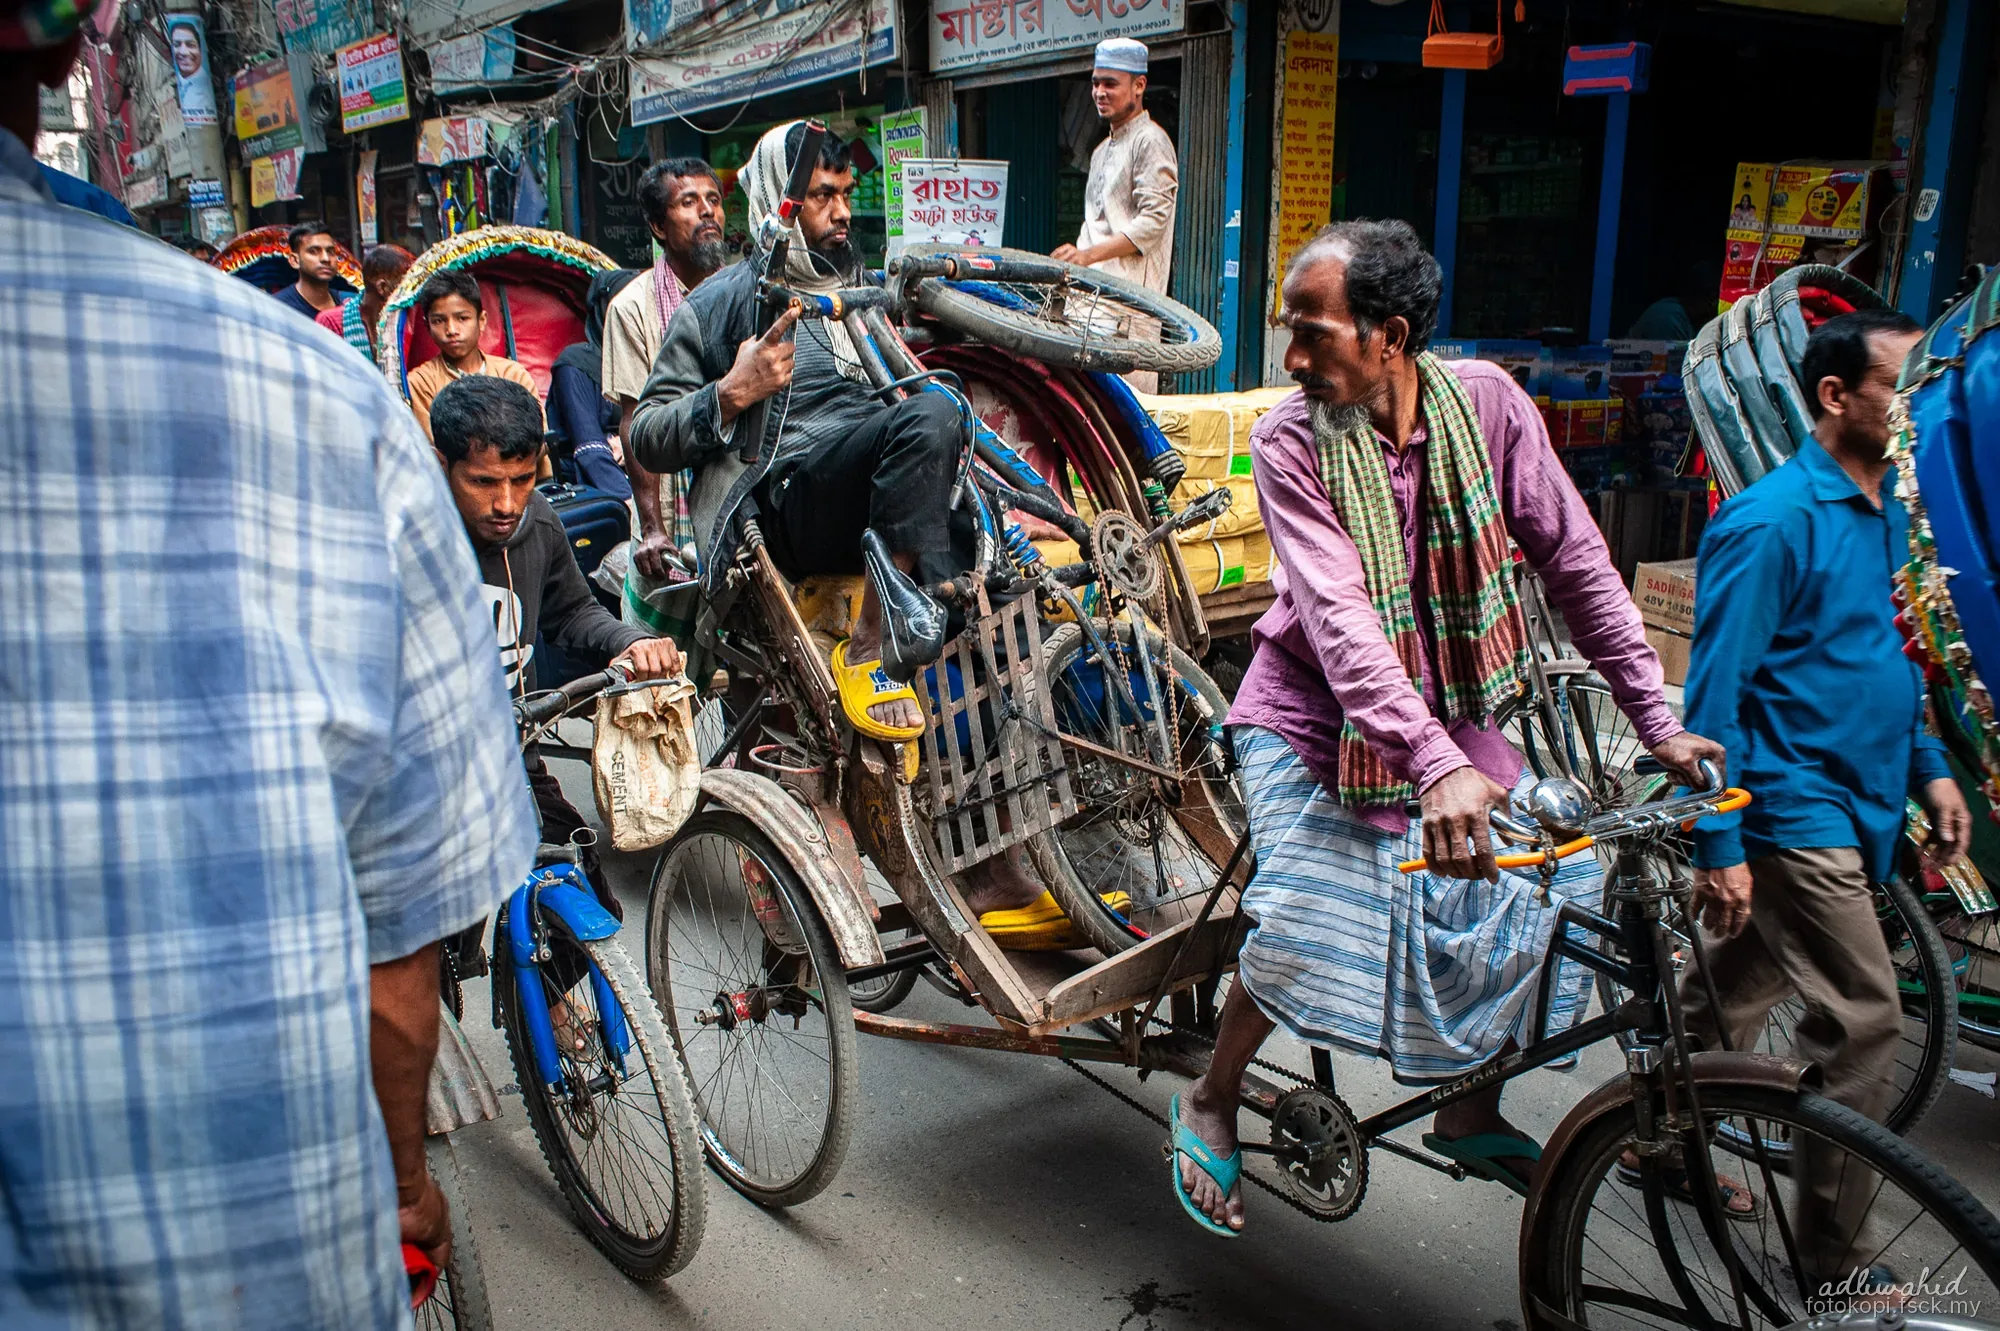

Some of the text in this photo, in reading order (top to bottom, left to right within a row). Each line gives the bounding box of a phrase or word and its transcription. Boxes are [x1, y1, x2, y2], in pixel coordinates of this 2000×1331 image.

[1288, 56, 1335, 76] একদাম
[886, 124, 921, 142] RUNNER
[909, 177, 1002, 204] রাহাত
[952, 203, 999, 227] হাউজ
[611, 751, 628, 814] CEMENT
